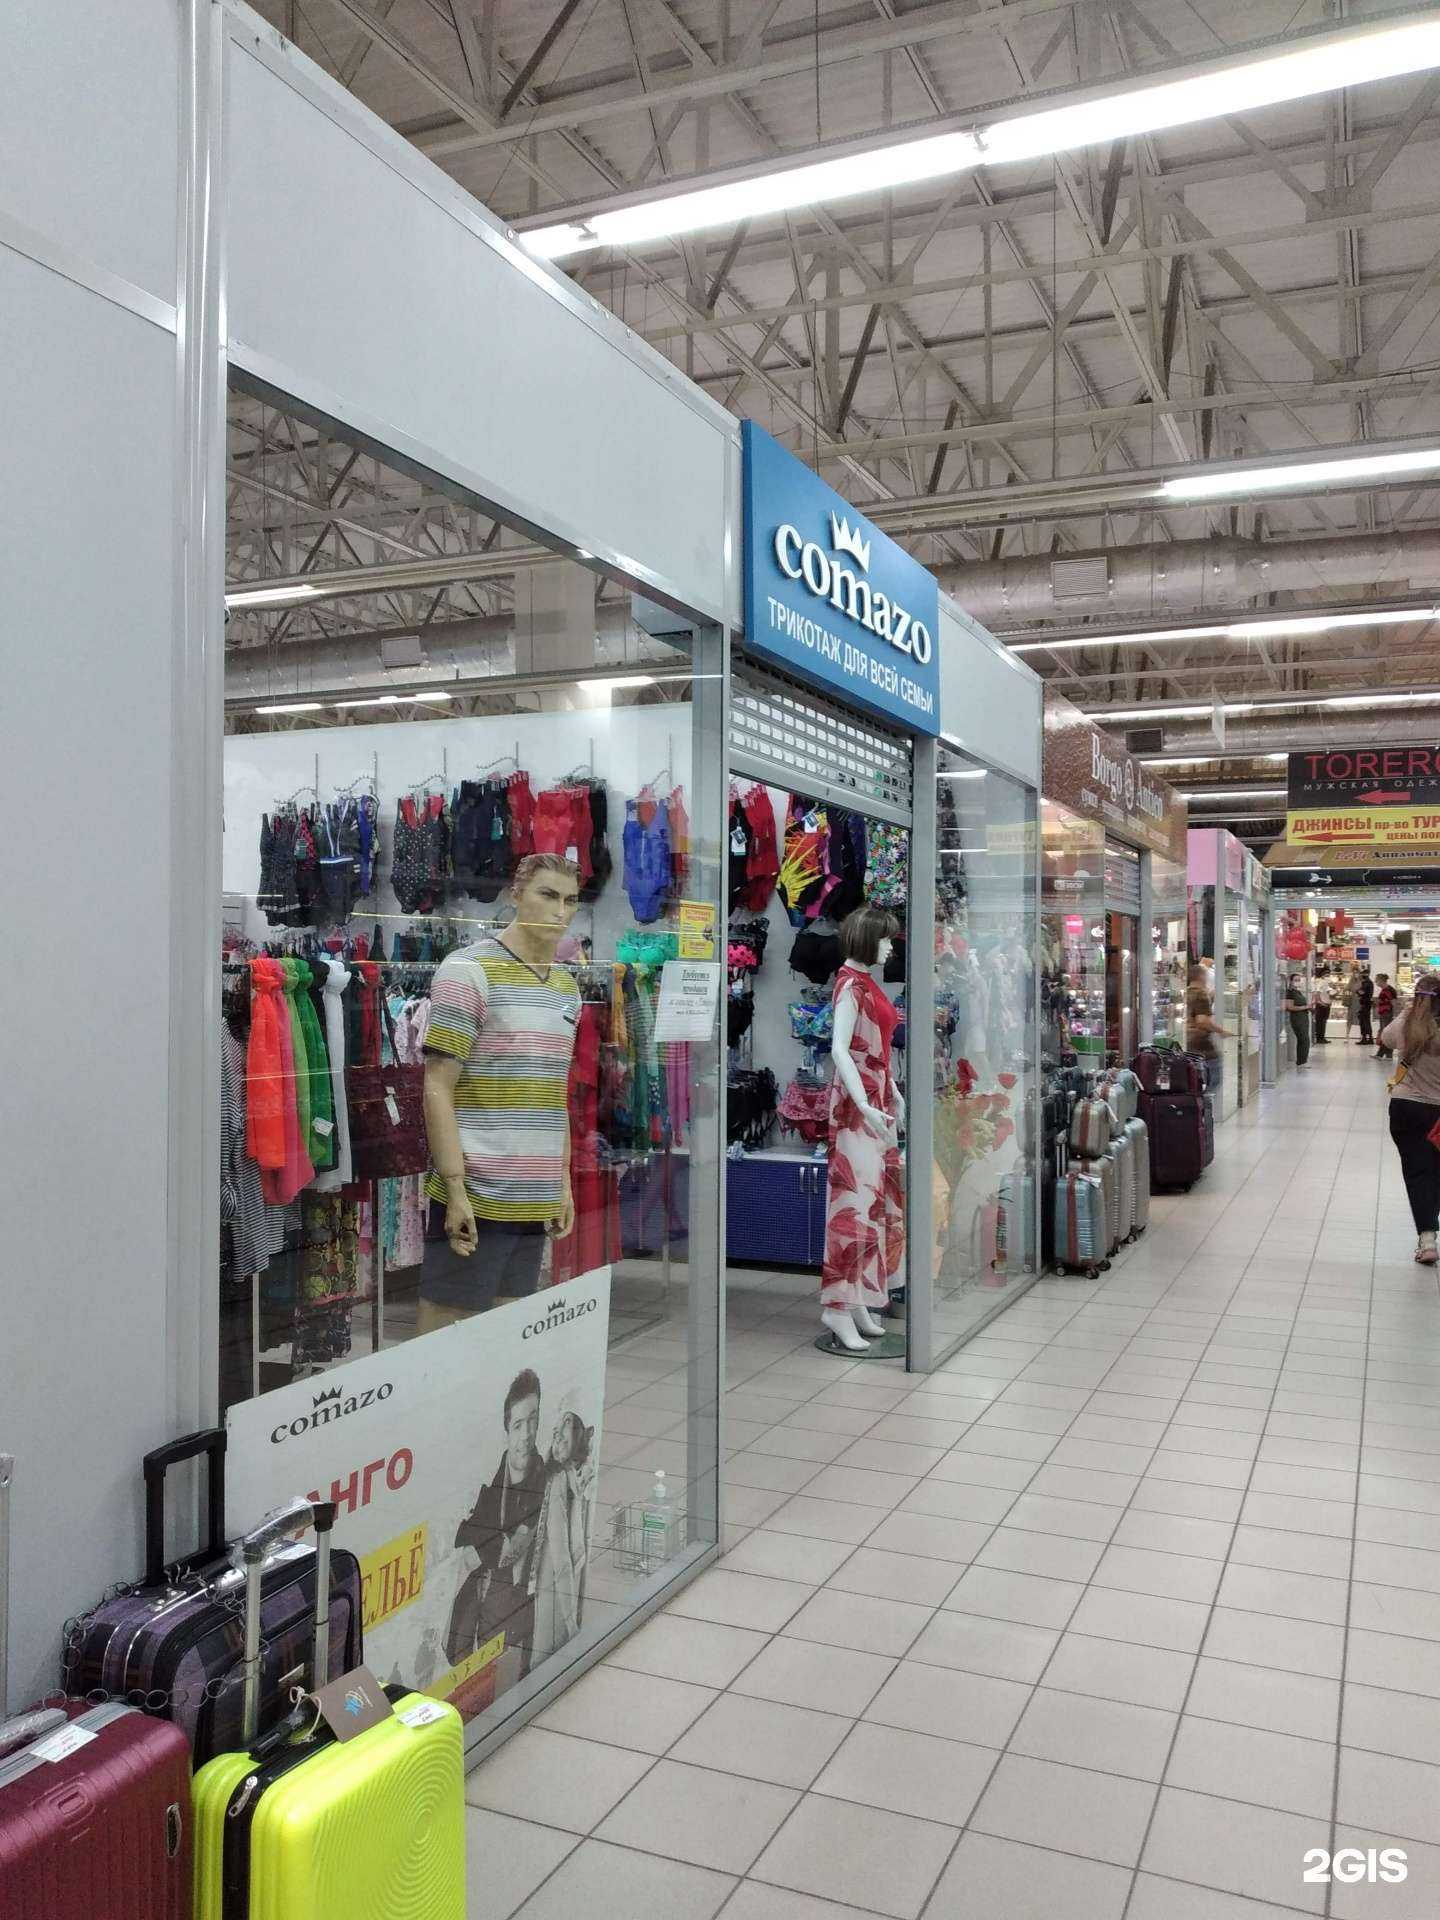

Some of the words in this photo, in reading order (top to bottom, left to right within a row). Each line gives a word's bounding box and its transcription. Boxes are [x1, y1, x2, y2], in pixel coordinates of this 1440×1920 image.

[775, 523, 932, 665] comazo
[768, 596, 841, 665] ТРИКОТАЖ
[843, 642, 868, 677] ДЛЯ
[870, 657, 899, 697] ВСЕЙ
[900, 677, 934, 716] СЕМЬИ
[1091, 732, 1123, 802] Borgo
[1303, 750, 1440, 780] TORER
[1303, 780, 1379, 791] МУЖСКАЯ
[1291, 816, 1372, 834] ДЖИНСЫ
[1374, 821, 1409, 830] пр-во
[1386, 832, 1418, 841] ЦЕНЫ
[521, 1298, 597, 1341] comazo
[270, 1382, 394, 1444] comazo
